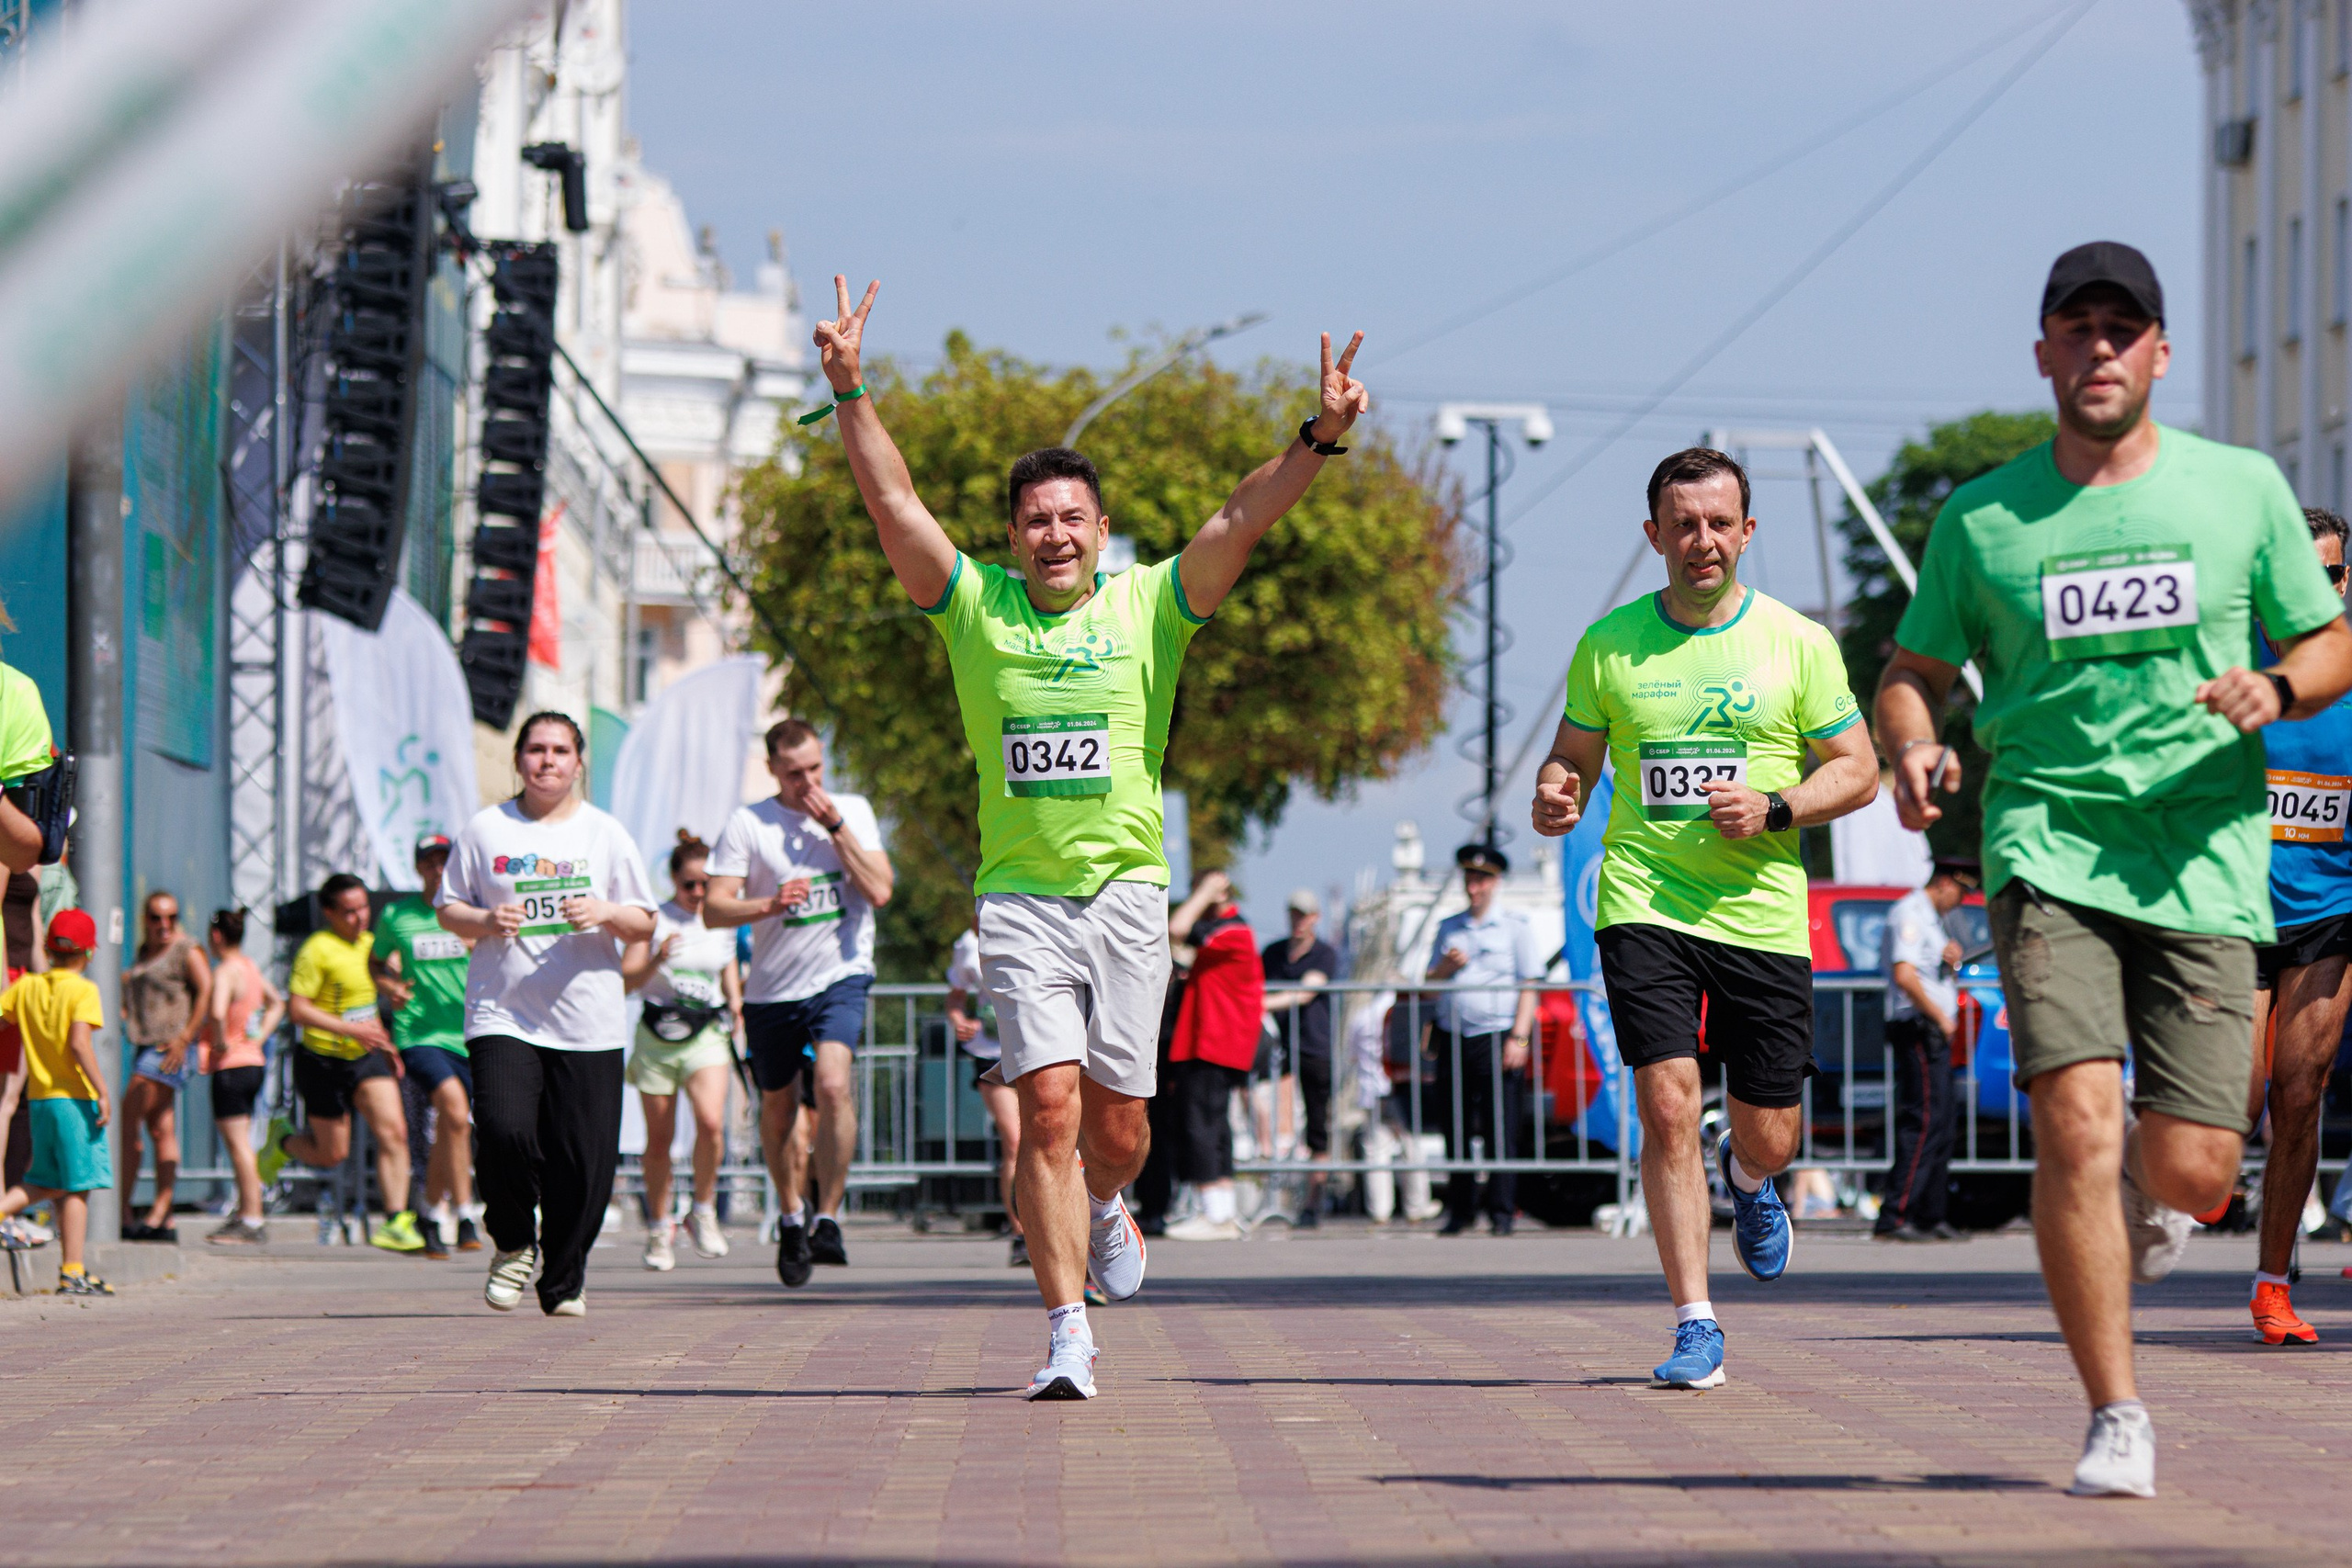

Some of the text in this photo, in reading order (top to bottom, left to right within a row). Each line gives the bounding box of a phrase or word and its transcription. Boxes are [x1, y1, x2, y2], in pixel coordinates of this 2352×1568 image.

[2060, 574, 2181, 626] 0423
[1637, 680, 1681, 690] зелёный
[1632, 689, 1677, 699] марафон
[1011, 738, 1101, 773] 0342
[2284, 828, 2297, 839] 10
